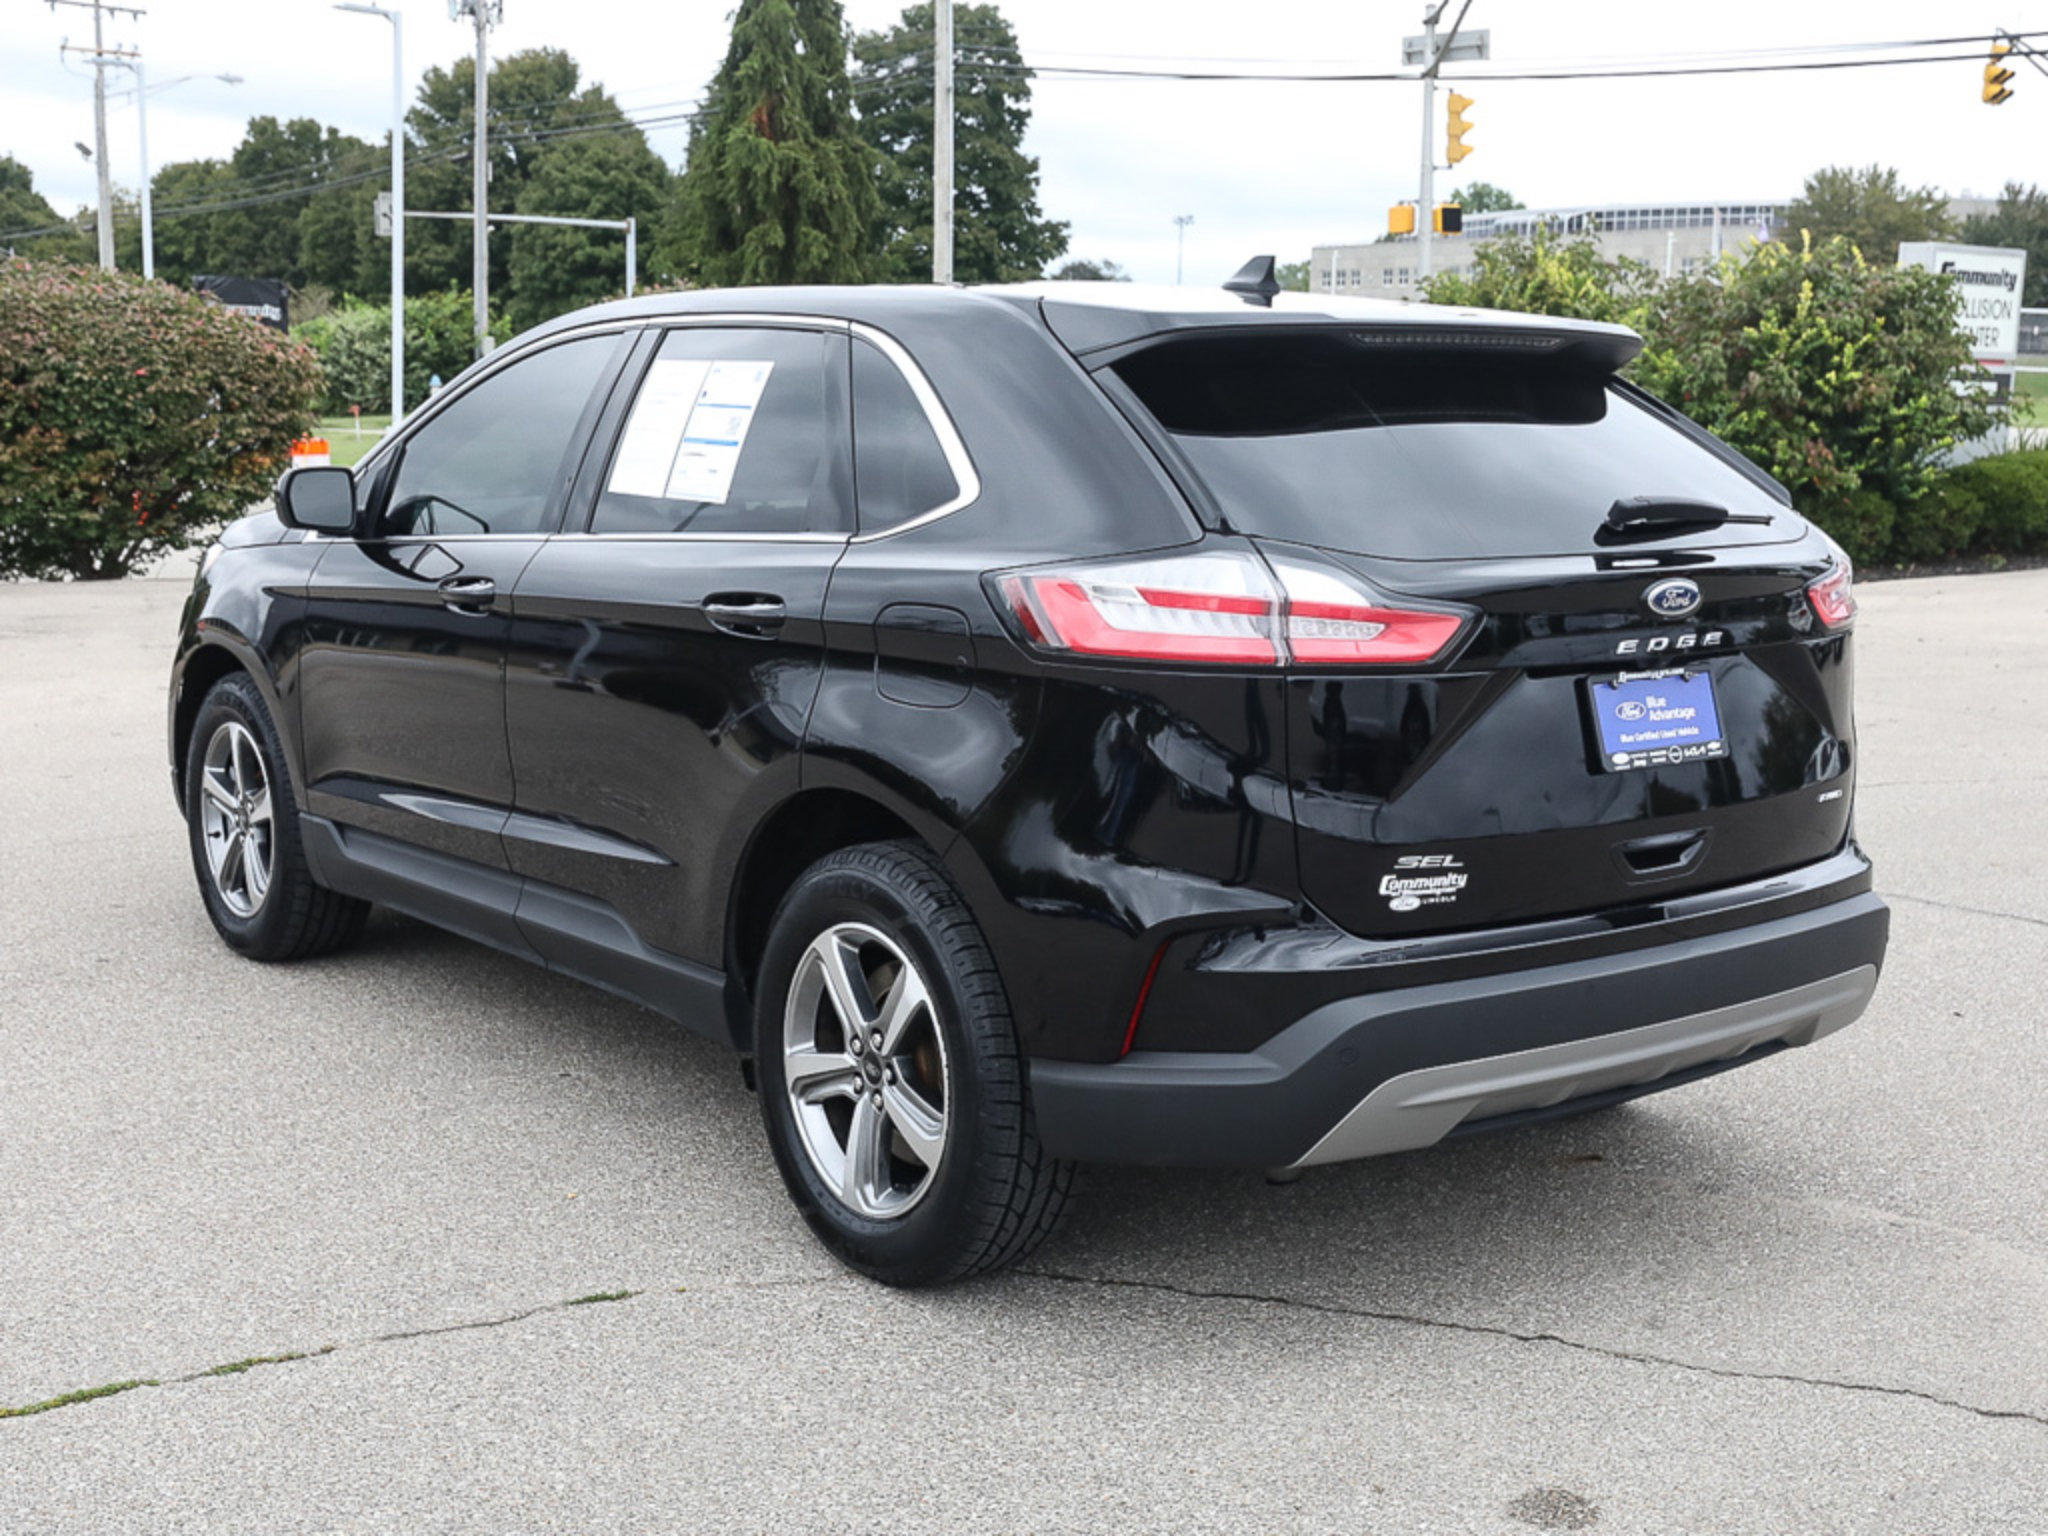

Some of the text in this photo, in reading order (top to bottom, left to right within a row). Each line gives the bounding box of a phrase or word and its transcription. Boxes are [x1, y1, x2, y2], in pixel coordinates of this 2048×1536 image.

[1941, 261, 2017, 292] Cmmunity
[1616, 631, 1723, 654] EDGE
[1645, 696, 1667, 708] Blue
[1649, 706, 1696, 721] Advantage
[1393, 854, 1463, 868] SEL
[1379, 871, 1468, 896] Community
